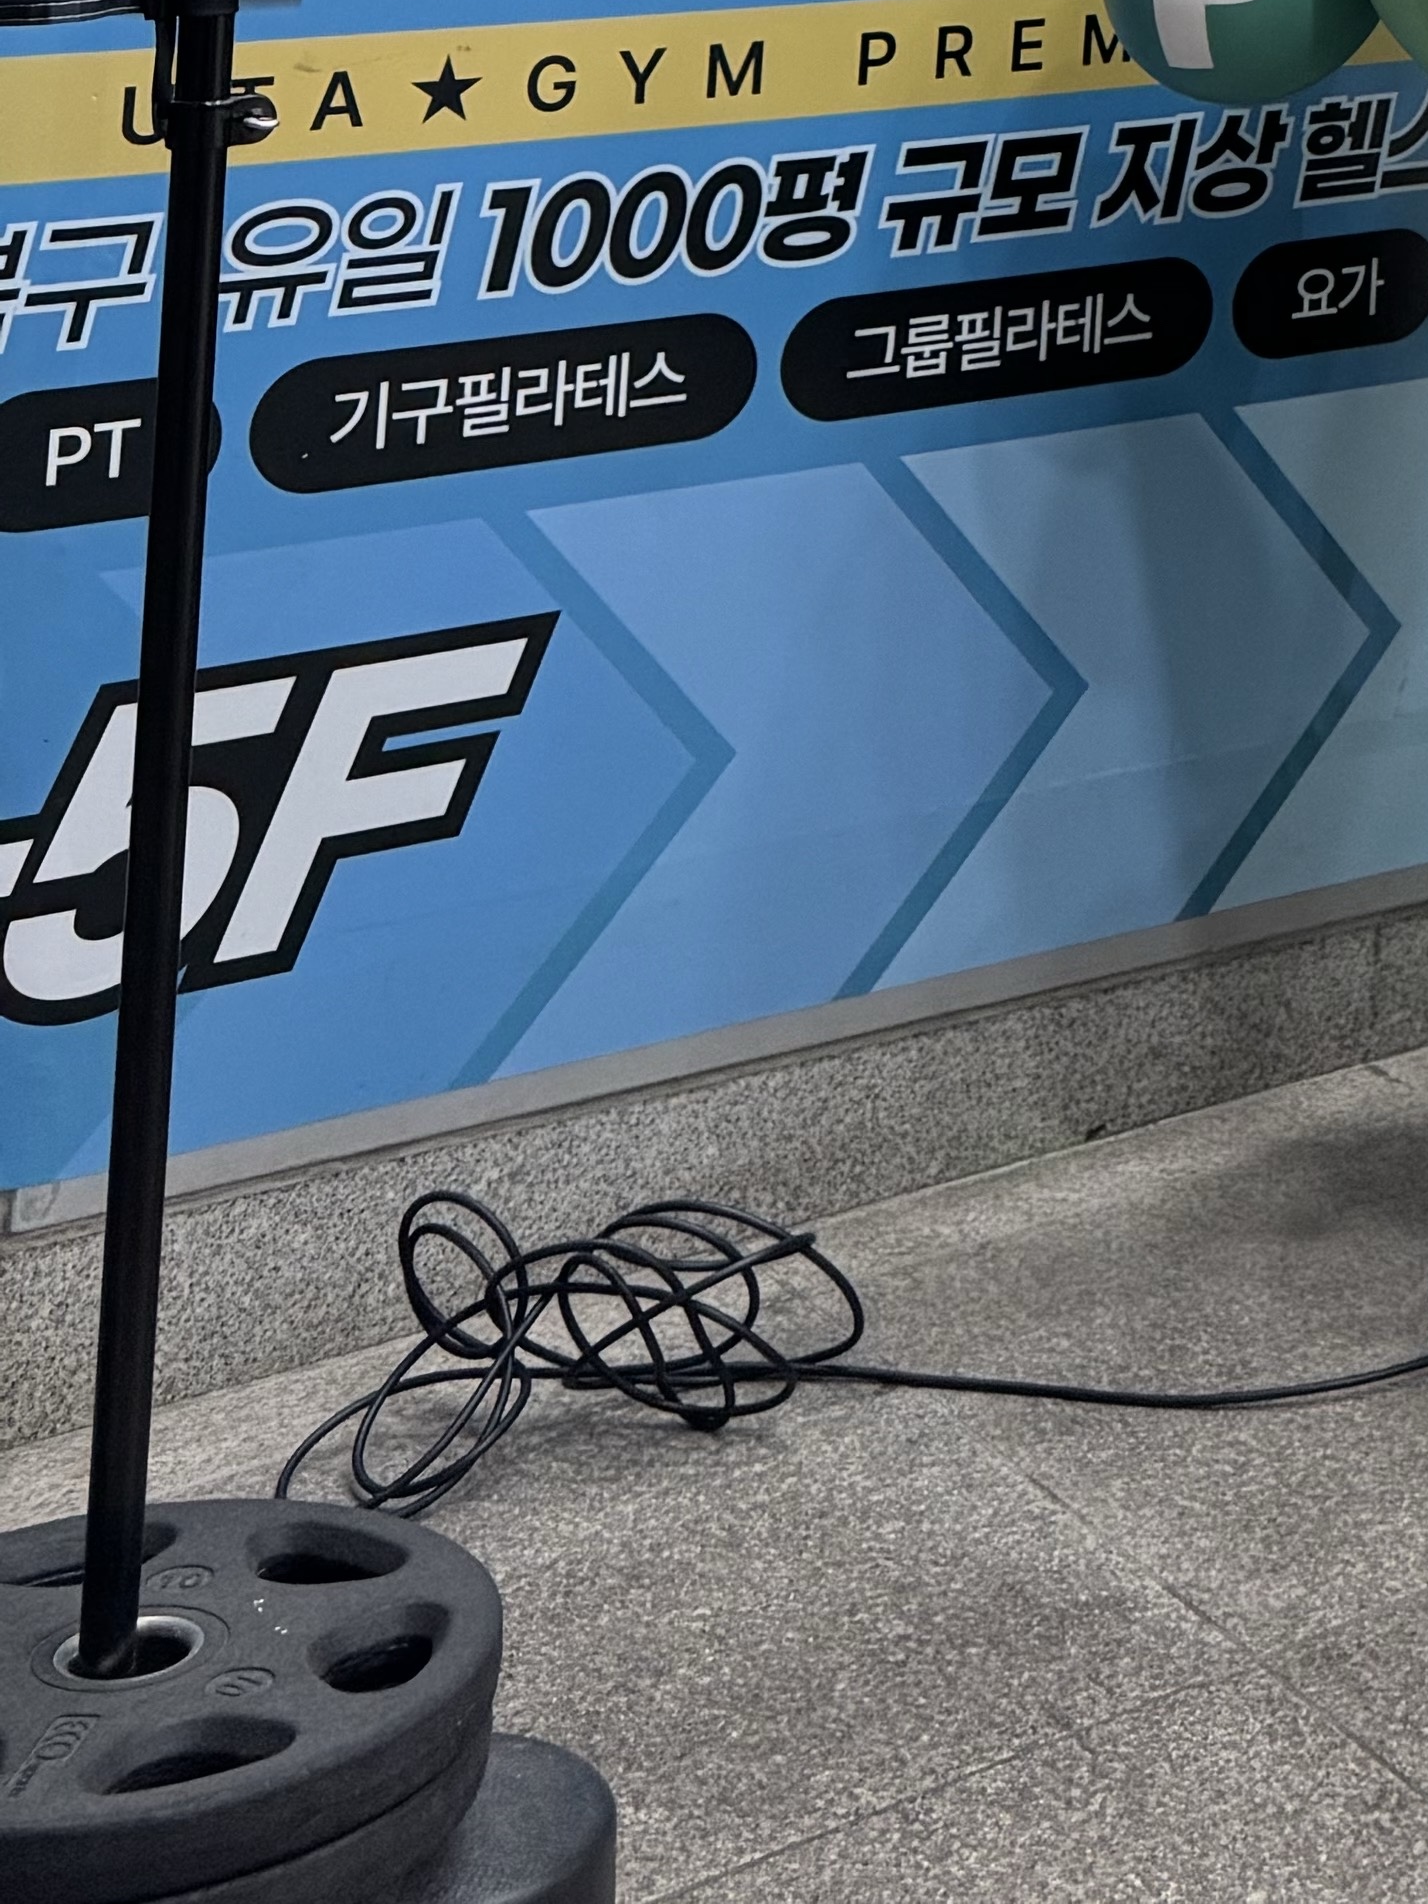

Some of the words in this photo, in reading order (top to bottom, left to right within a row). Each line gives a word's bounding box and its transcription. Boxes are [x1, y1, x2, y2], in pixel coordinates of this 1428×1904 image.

[0, 212, 165, 353] 구
[221, 182, 465, 332] 유일
[477, 144, 872, 300] 1000평
[878, 123, 1091, 262] 규모
[1091, 102, 1292, 229] 지상
[845, 290, 1153, 380] 그룹필라테스
[1291, 256, 1385, 321] 요가
[329, 349, 688, 451] 기구필라테스
[44, 416, 142, 487] PT
[0, 635, 530, 1004] 5F
